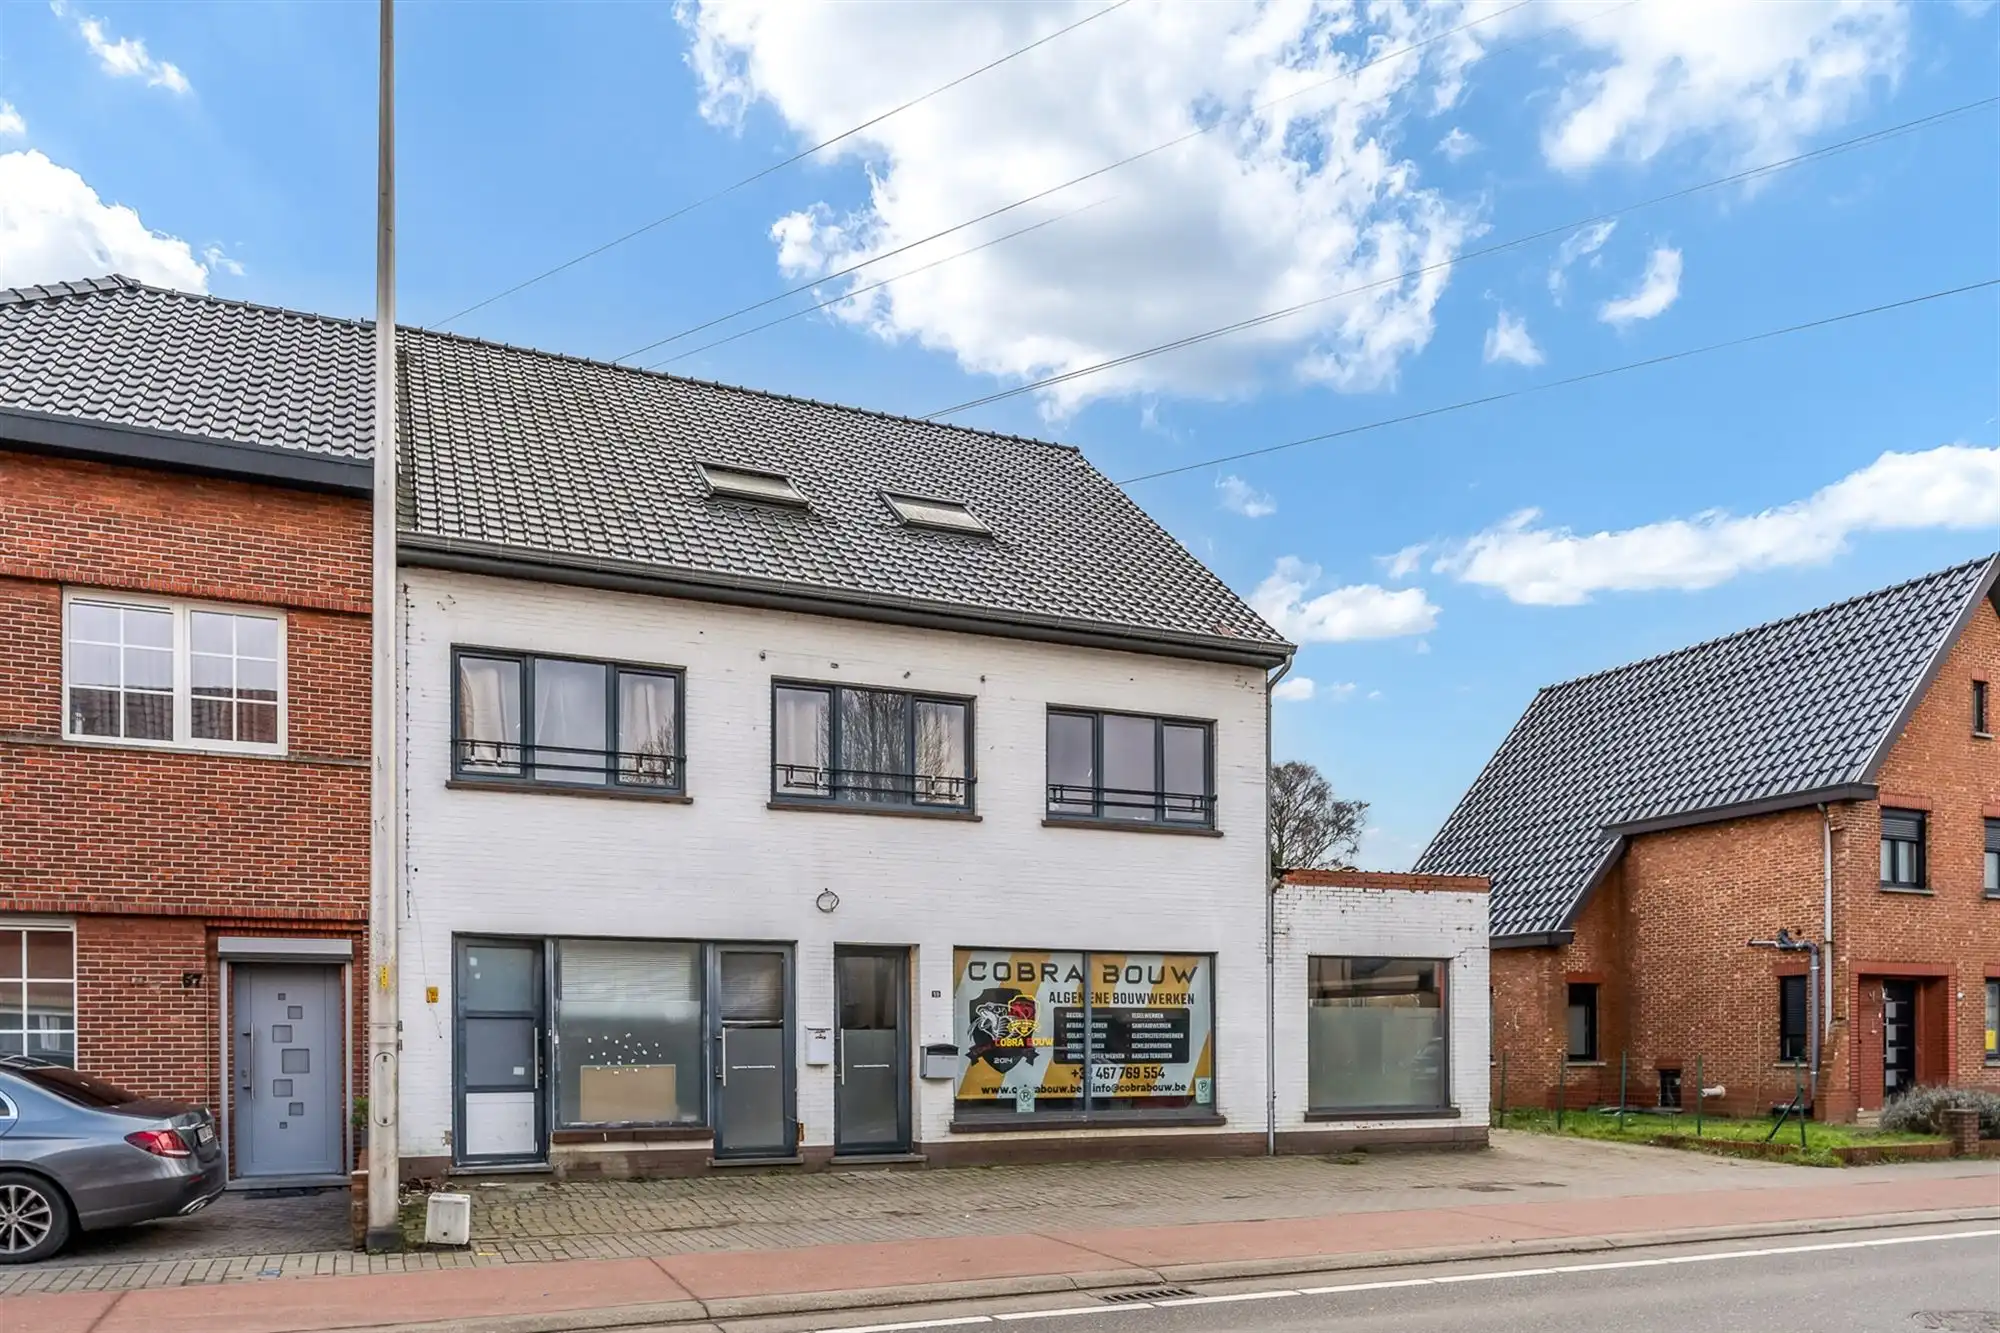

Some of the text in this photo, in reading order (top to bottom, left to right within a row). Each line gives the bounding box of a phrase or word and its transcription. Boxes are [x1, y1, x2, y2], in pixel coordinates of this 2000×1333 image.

[968, 961, 1198, 985] COBRA BOUW
[1112, 992, 1195, 1005] BOUWWERKEN
[995, 1038, 1054, 1047] COBRA BOUW
[1095, 1067, 1117, 1080] 467
[1119, 1066, 1141, 1079] 769
[1143, 1066, 1165, 1079] 554
[1092, 1082, 1187, 1093] info@cobrabouw.be
